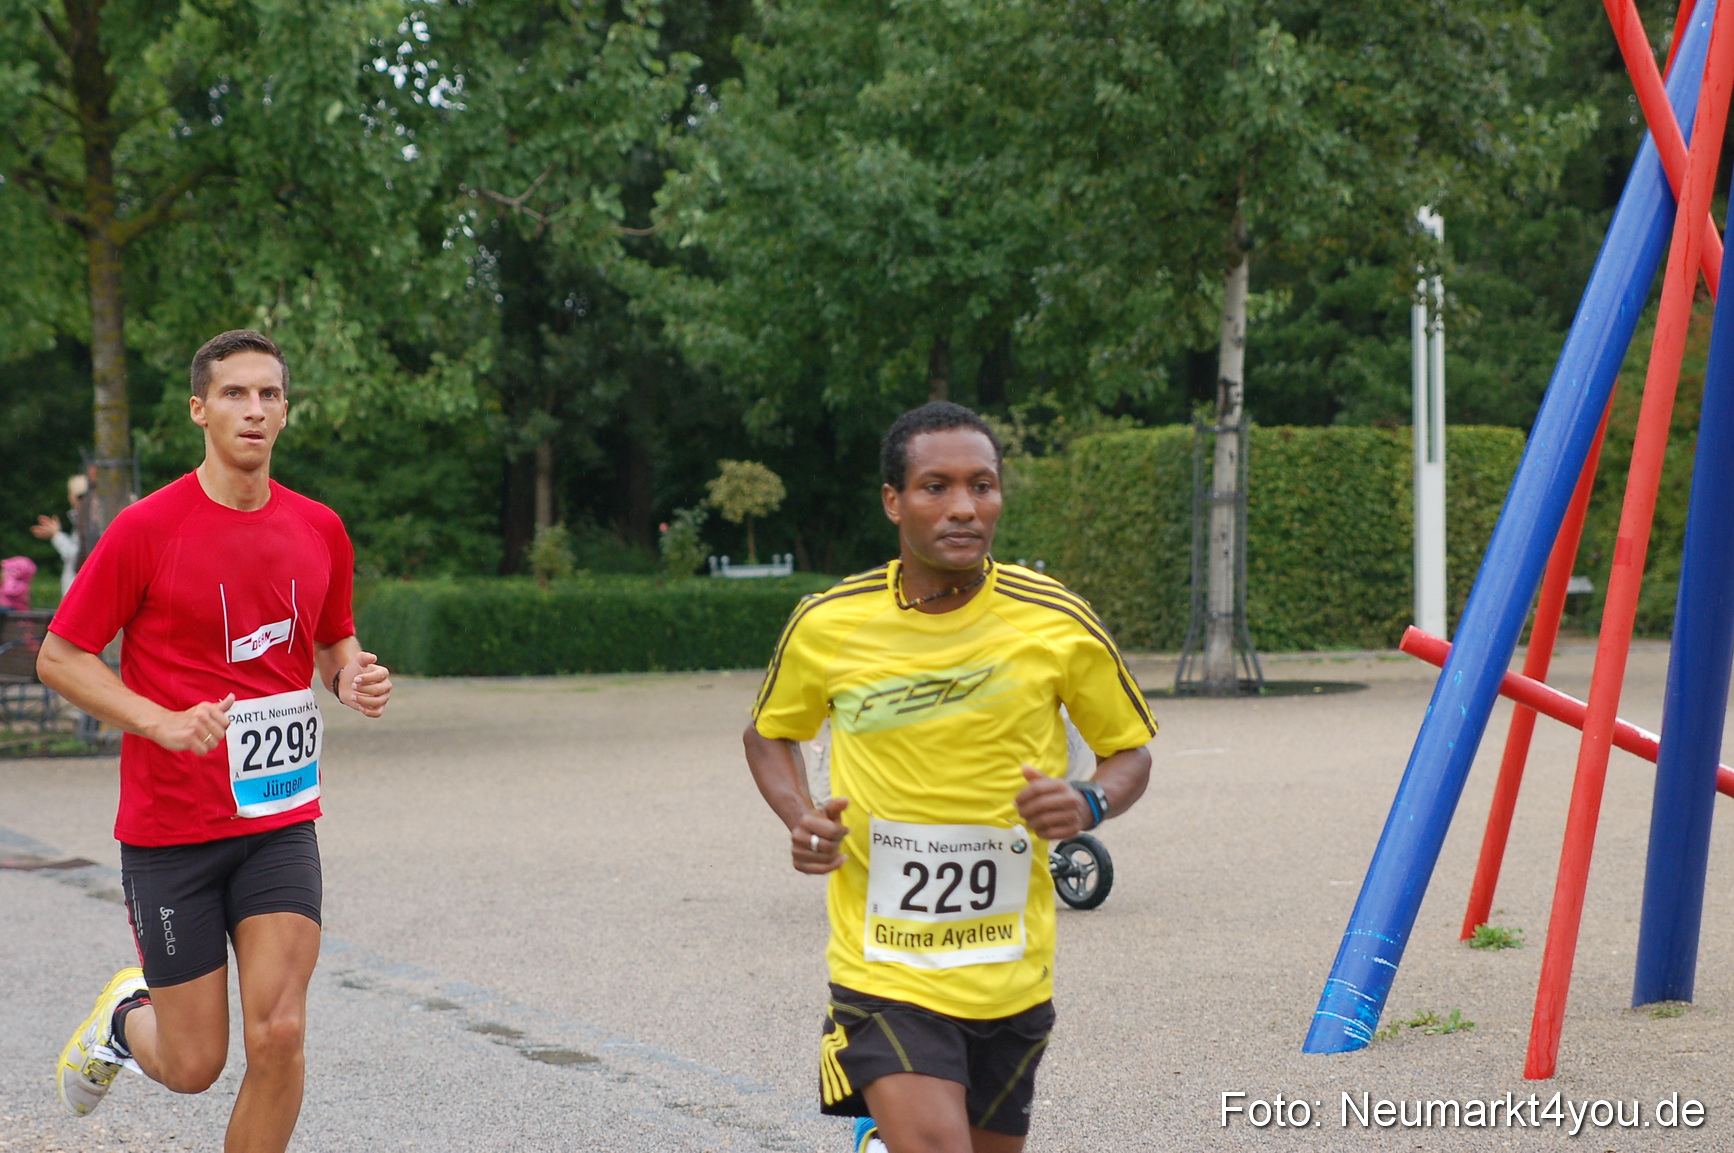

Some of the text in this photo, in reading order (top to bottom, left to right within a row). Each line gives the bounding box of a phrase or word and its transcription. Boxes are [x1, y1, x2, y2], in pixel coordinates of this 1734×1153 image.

[228, 702, 313, 725] PARTL Neumarkt
[241, 716, 317, 772] 2293
[263, 777, 303, 798] Jürgen
[873, 832, 1004, 854] PARTL Neumarkt
[900, 859, 997, 914] 229
[163, 920, 176, 956] odlo
[875, 923, 1013, 949] Girma Ayalew
